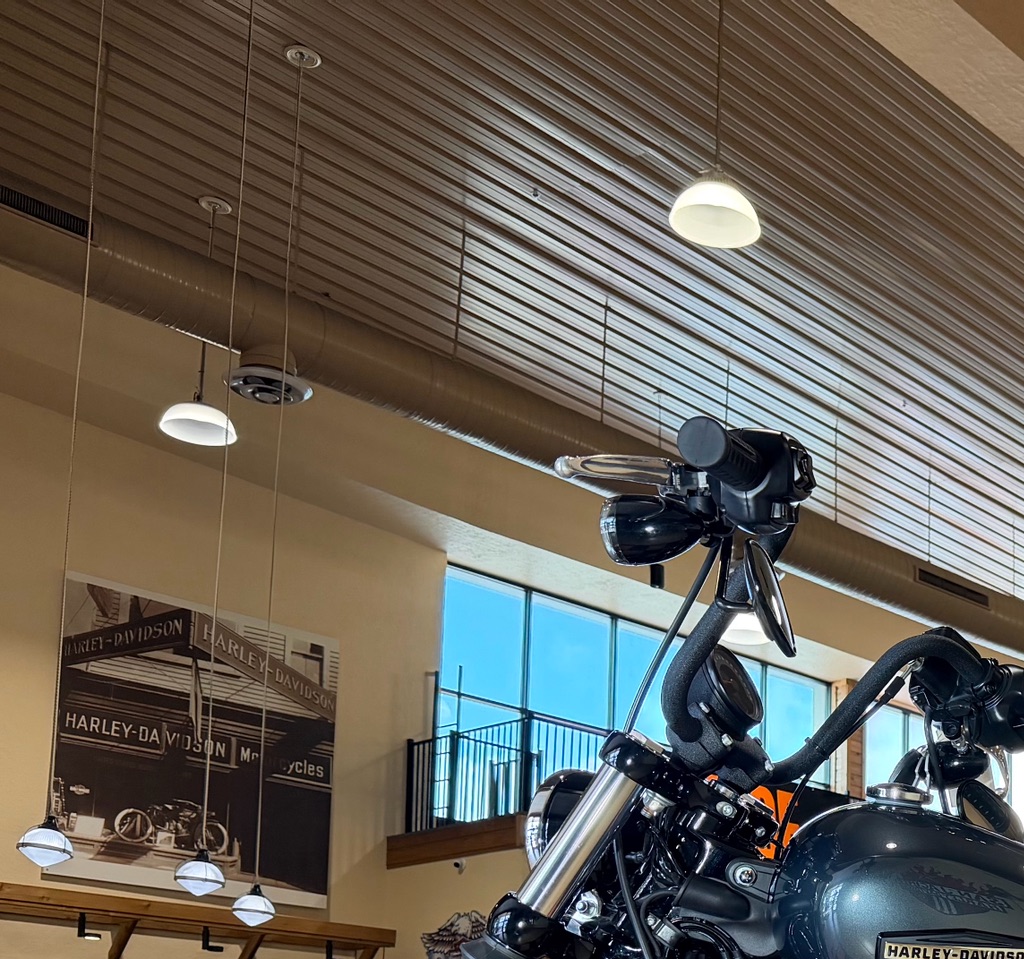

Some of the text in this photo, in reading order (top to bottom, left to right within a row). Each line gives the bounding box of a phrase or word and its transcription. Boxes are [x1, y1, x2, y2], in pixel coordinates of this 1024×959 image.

[64, 618, 183, 656] HARLEY-DAVIDSON
[202, 623, 336, 711] HARLEY-DAVIDSON
[64, 712, 226, 758] HARLEY-DAVIDSON
